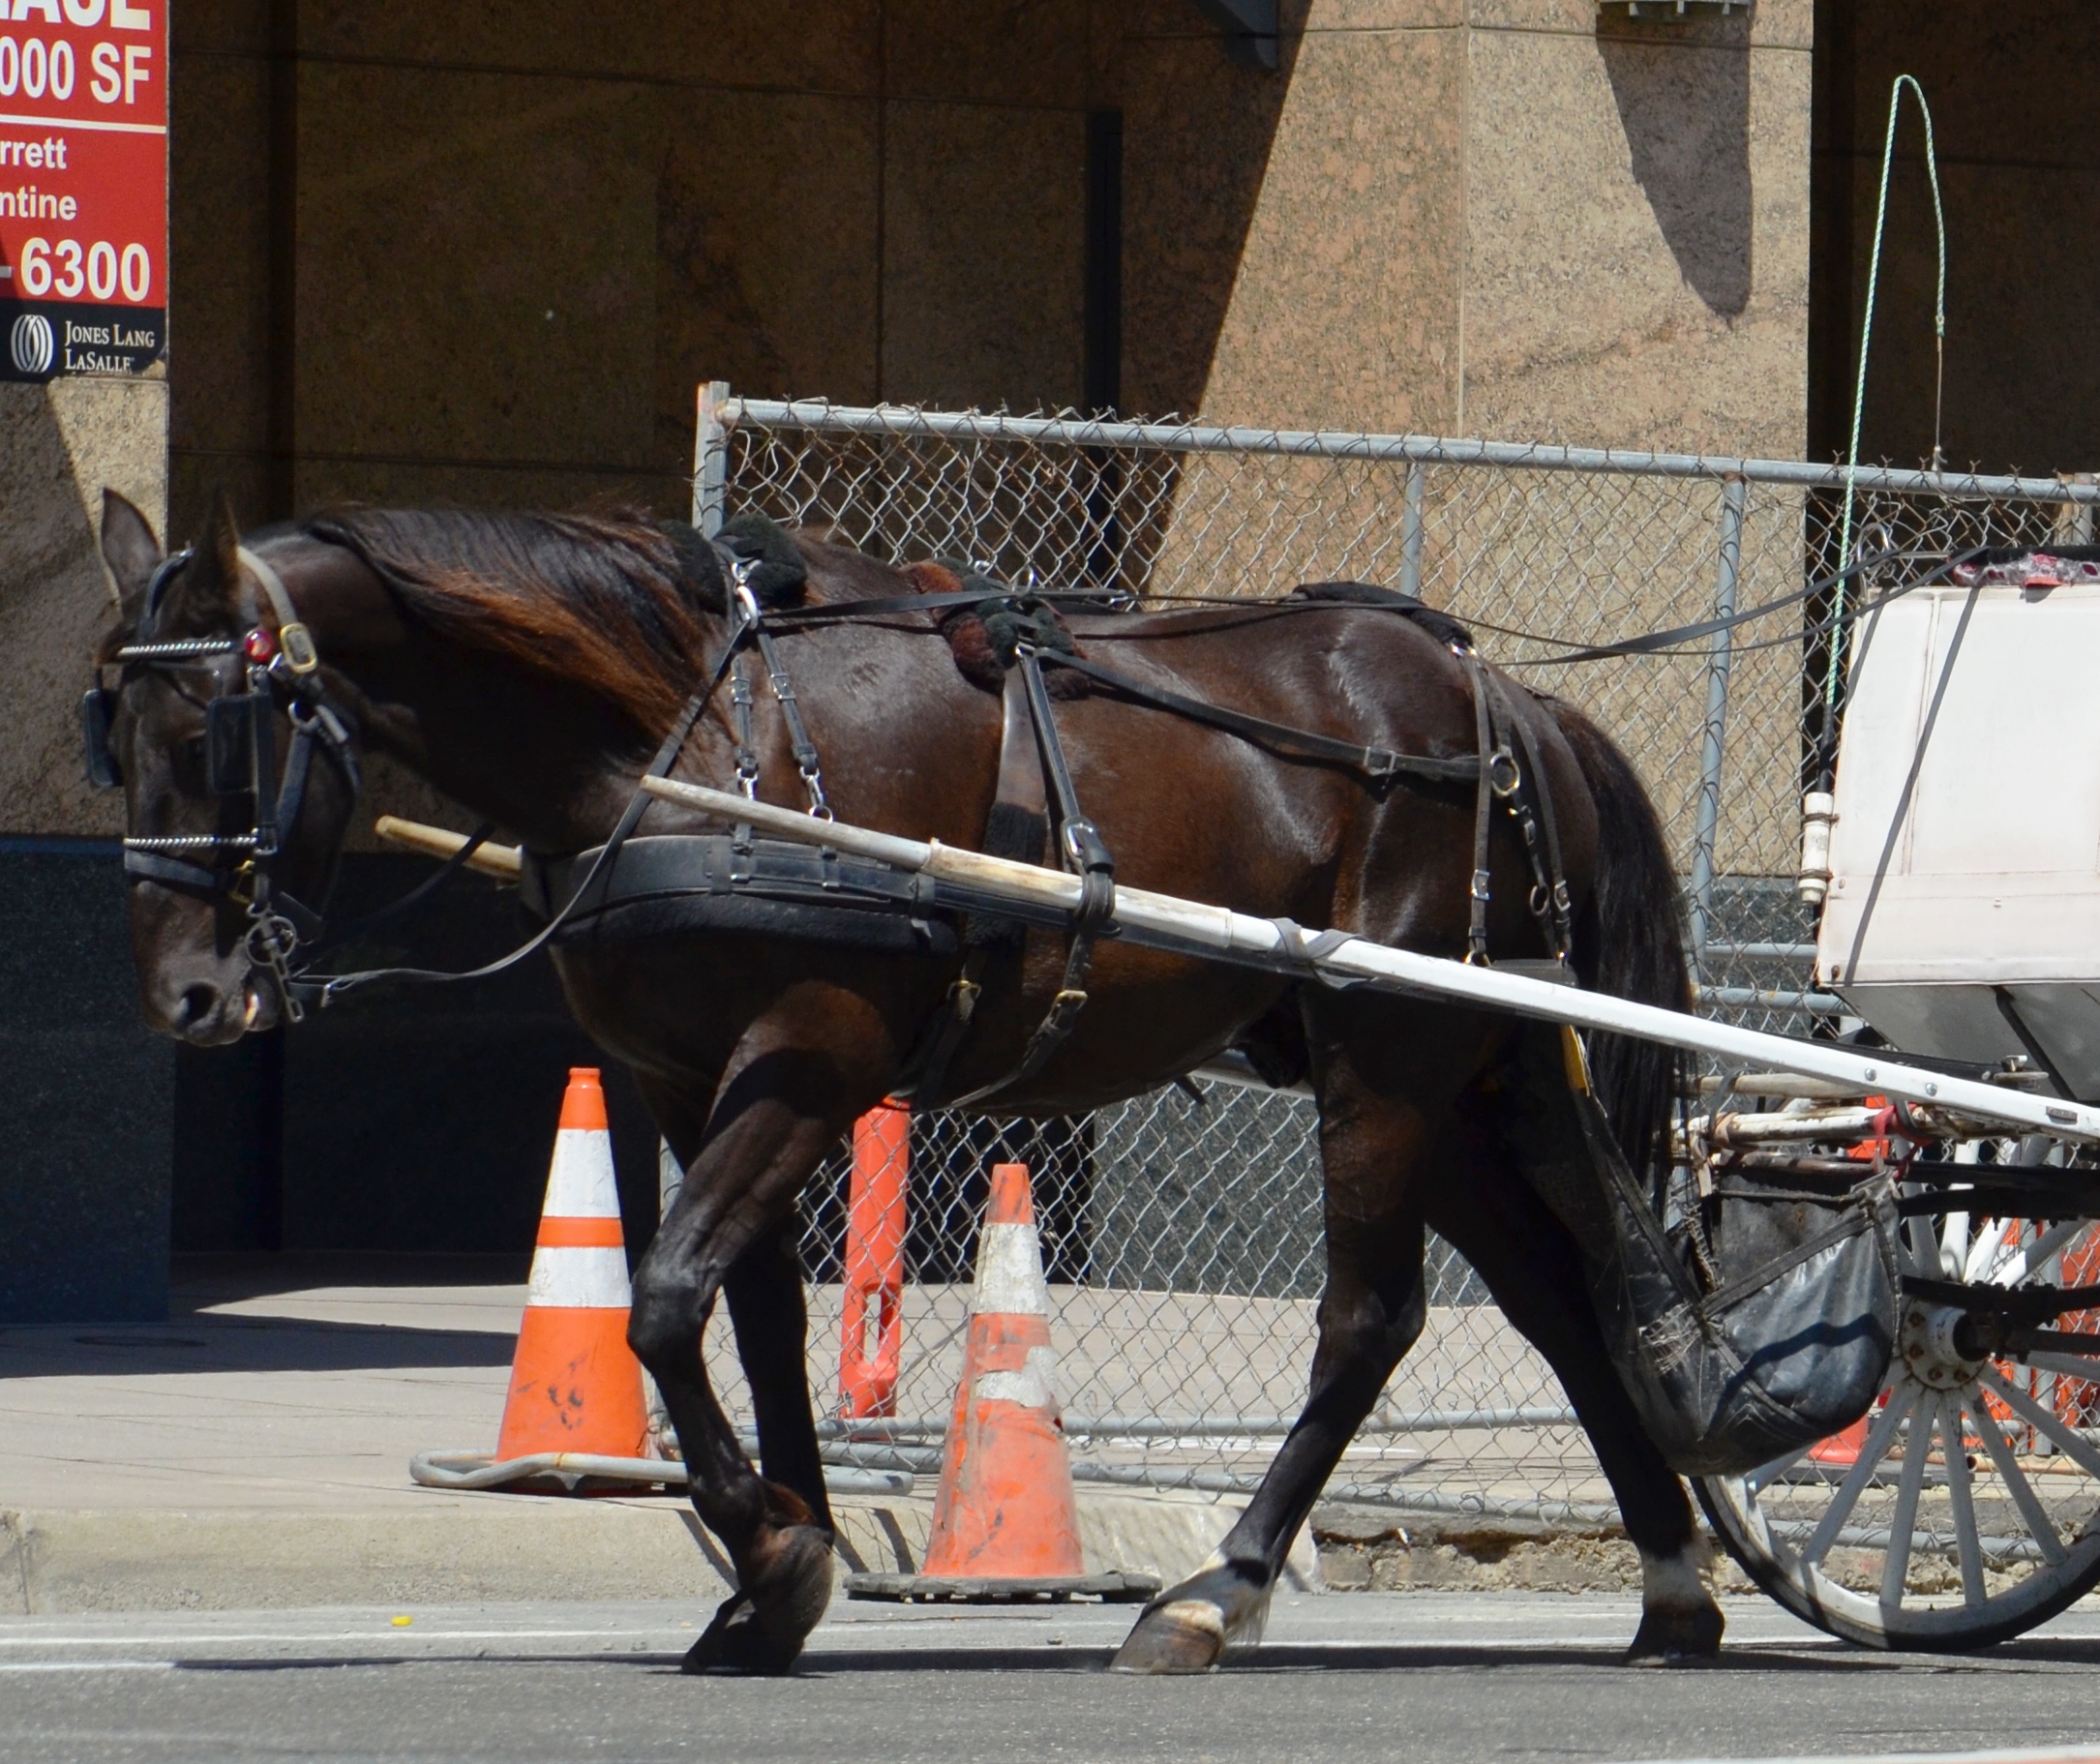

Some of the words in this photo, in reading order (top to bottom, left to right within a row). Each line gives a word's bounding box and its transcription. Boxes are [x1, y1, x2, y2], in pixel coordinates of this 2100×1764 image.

[0, 36, 75, 100] 000
[91, 42, 152, 105] SF
[0, 186, 77, 221] ntine
[65, 320, 110, 346] JONES
[113, 324, 155, 347] LANG
